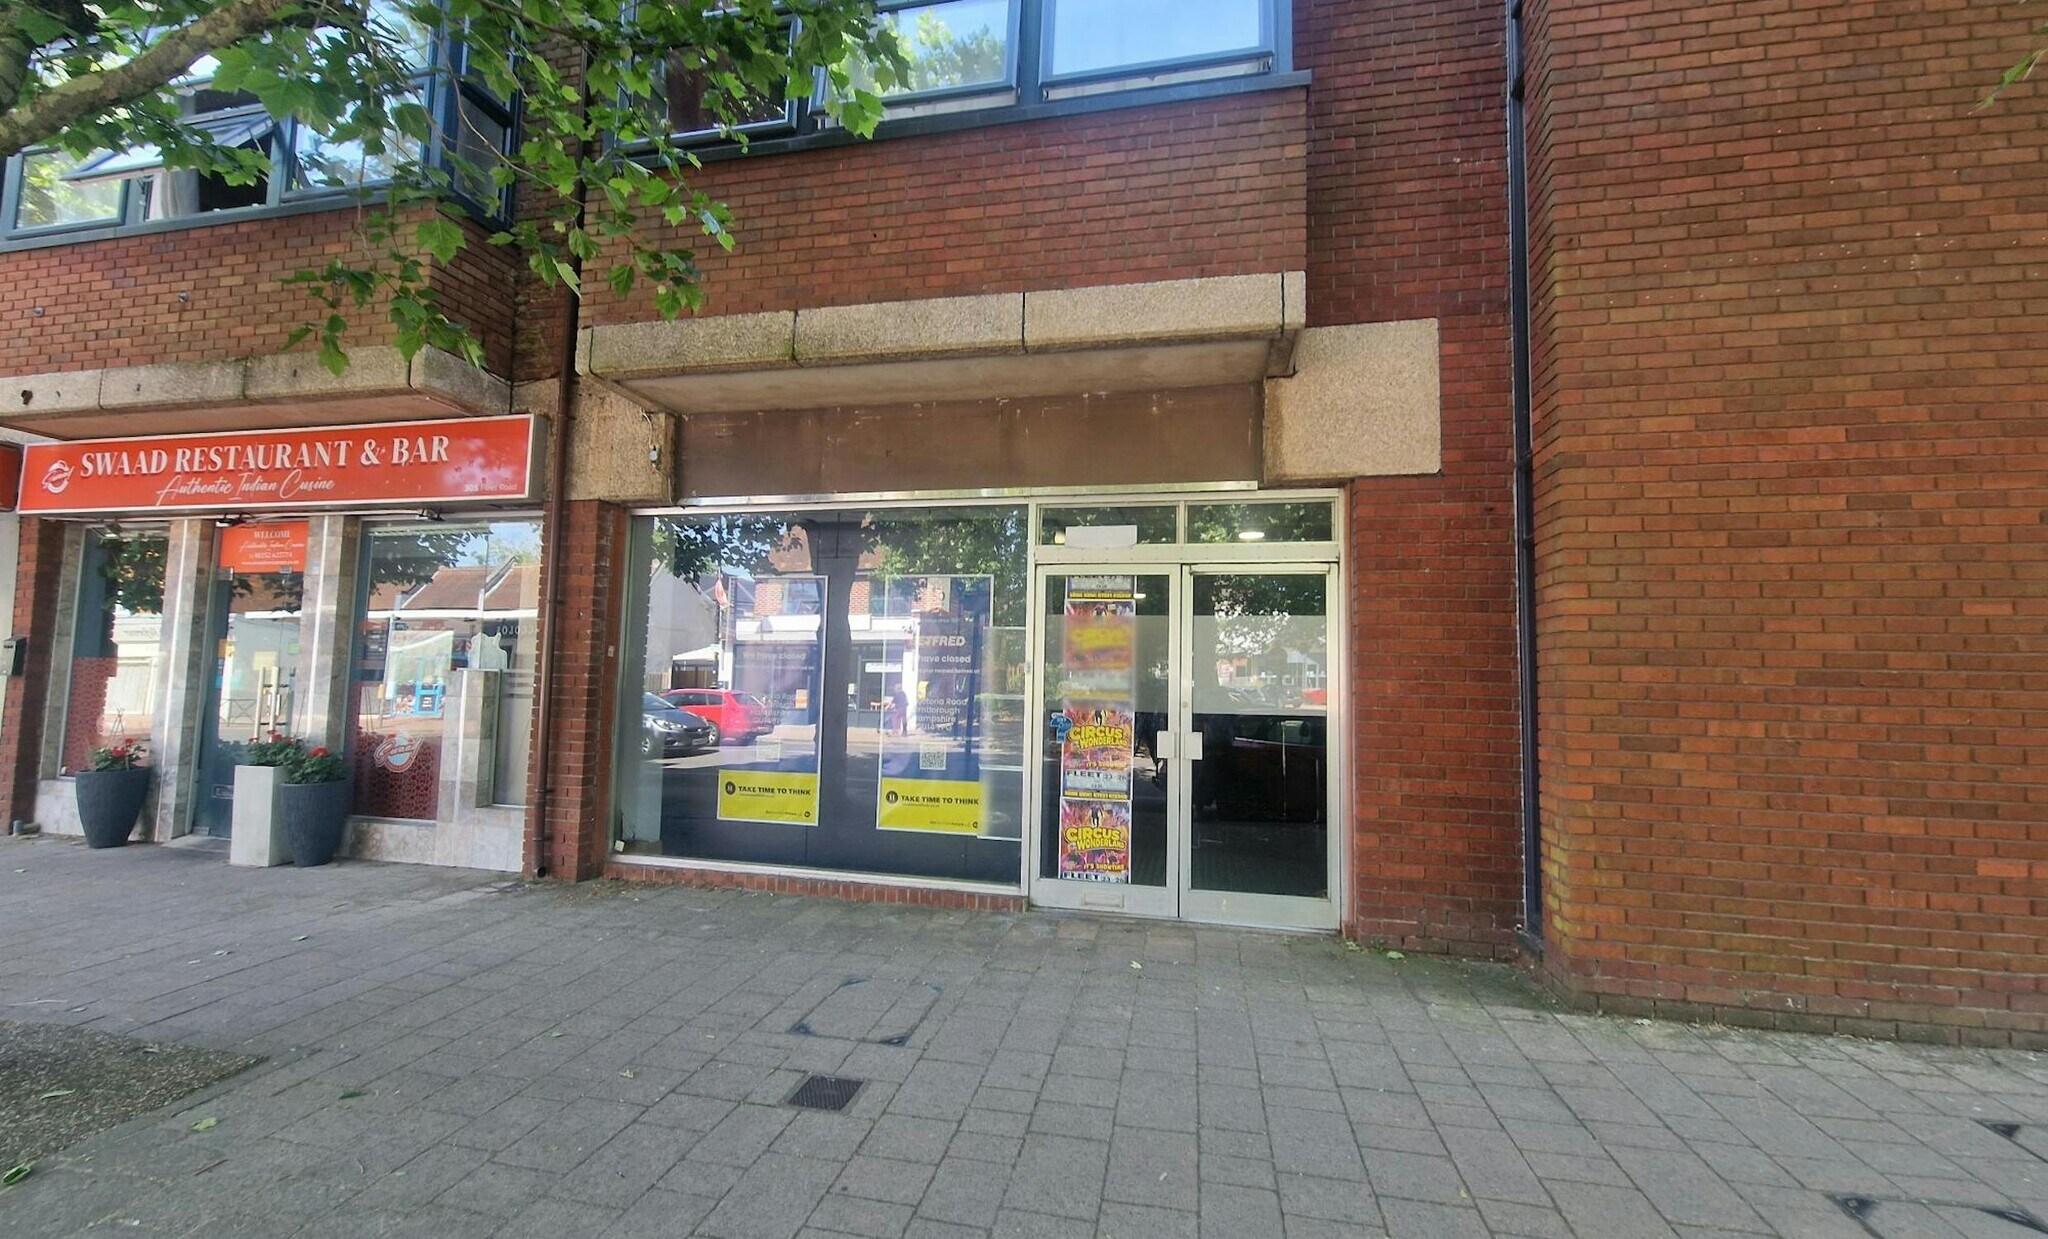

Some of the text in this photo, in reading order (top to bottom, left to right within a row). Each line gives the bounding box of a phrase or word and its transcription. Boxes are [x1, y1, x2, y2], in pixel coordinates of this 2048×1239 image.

[81, 450, 167, 477] SWAAD
[174, 440, 353, 474] RESTAURANT
[361, 439, 380, 466] &
[391, 435, 449, 466] BAR
[157, 469, 335, 506] Authentic Indian Cusine
[254, 530, 290, 538] WELCOME
[914, 635, 966, 647] ETFRED
[941, 654, 971, 663] closed
[945, 696, 968, 706] Road
[1068, 725, 1124, 741] CIRCUS
[1079, 736, 1128, 749] WONDERLAND
[1066, 770, 1100, 778] FLEET
[738, 785, 756, 793] TAKE
[757, 786, 775, 794] TIME
[789, 788, 811, 796] THINK
[954, 798, 979, 806] THINK
[1065, 827, 1122, 842] CIRCUS
[1076, 838, 1126, 851] WONDERLAND
[1063, 872, 1100, 880] FLEET
